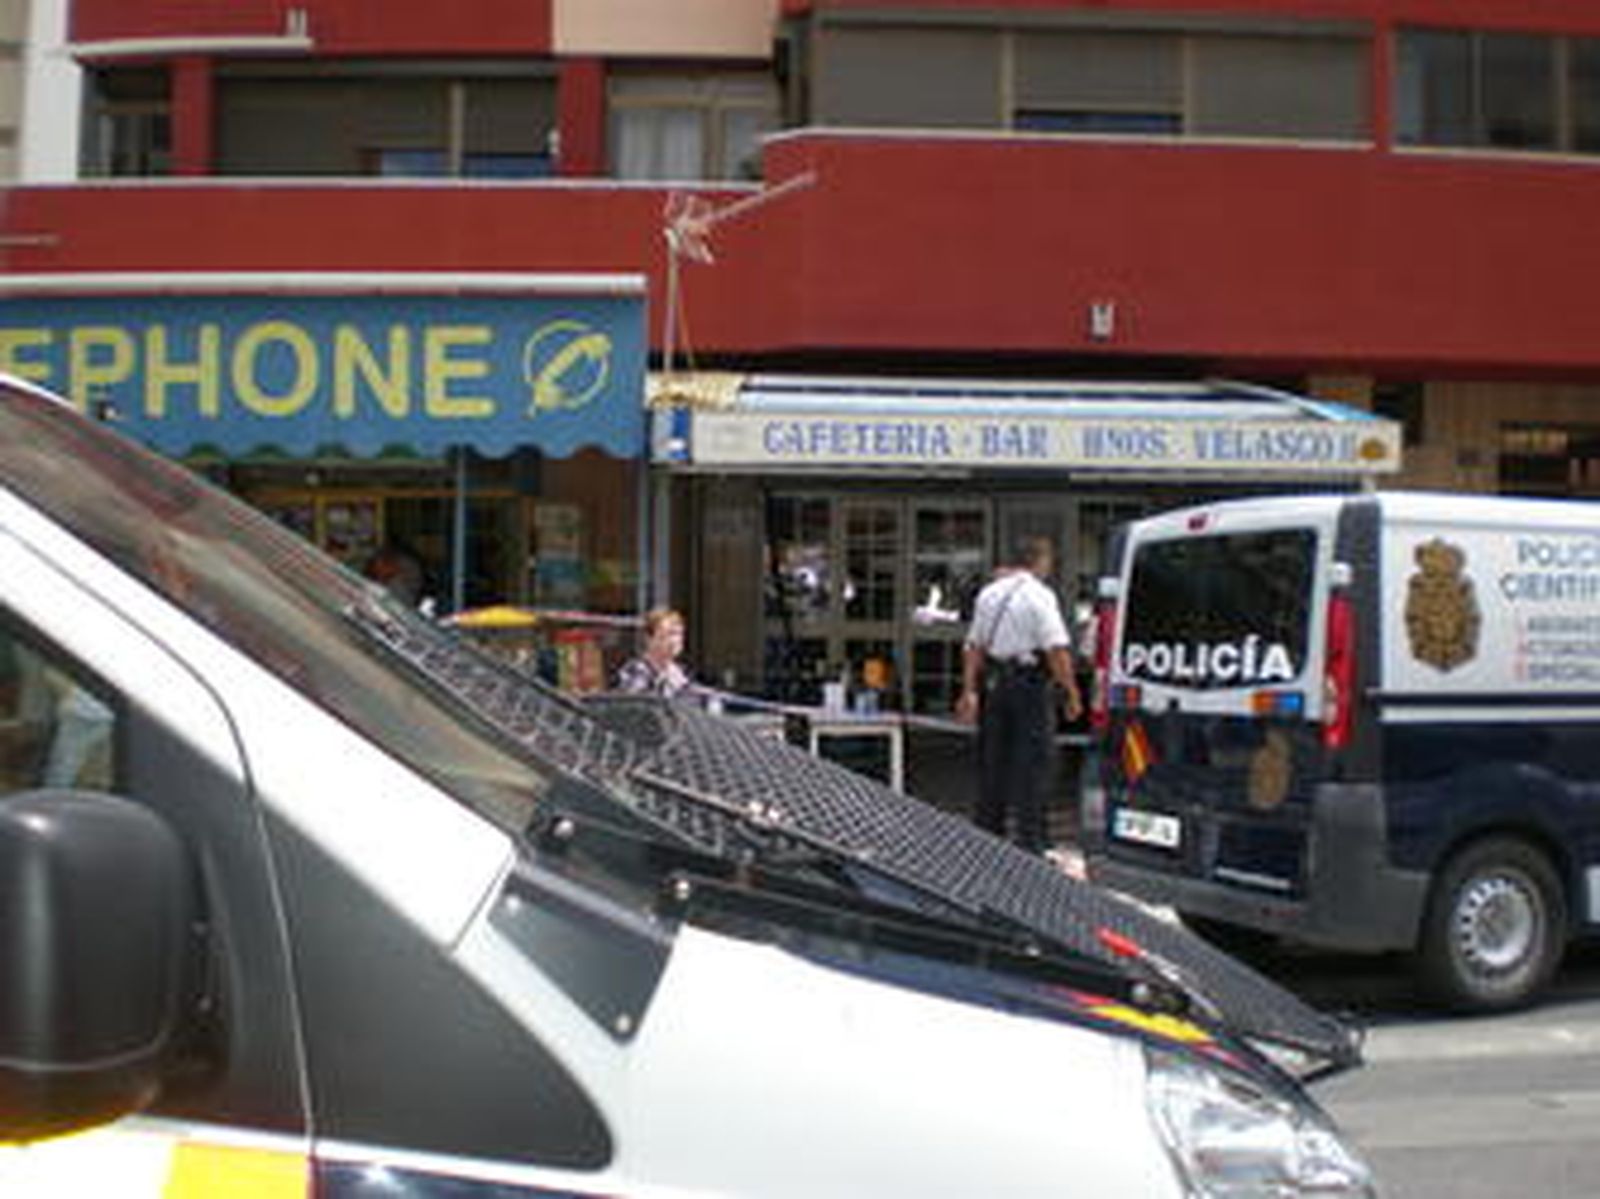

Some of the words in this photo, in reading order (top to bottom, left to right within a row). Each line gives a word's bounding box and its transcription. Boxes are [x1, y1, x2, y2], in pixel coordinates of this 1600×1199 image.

[763, 419, 952, 456] CAFETERIA
[981, 424, 1048, 458] BAR
[1194, 427, 1334, 461] VELASCO
[1123, 634, 1294, 680] POLICÍA
